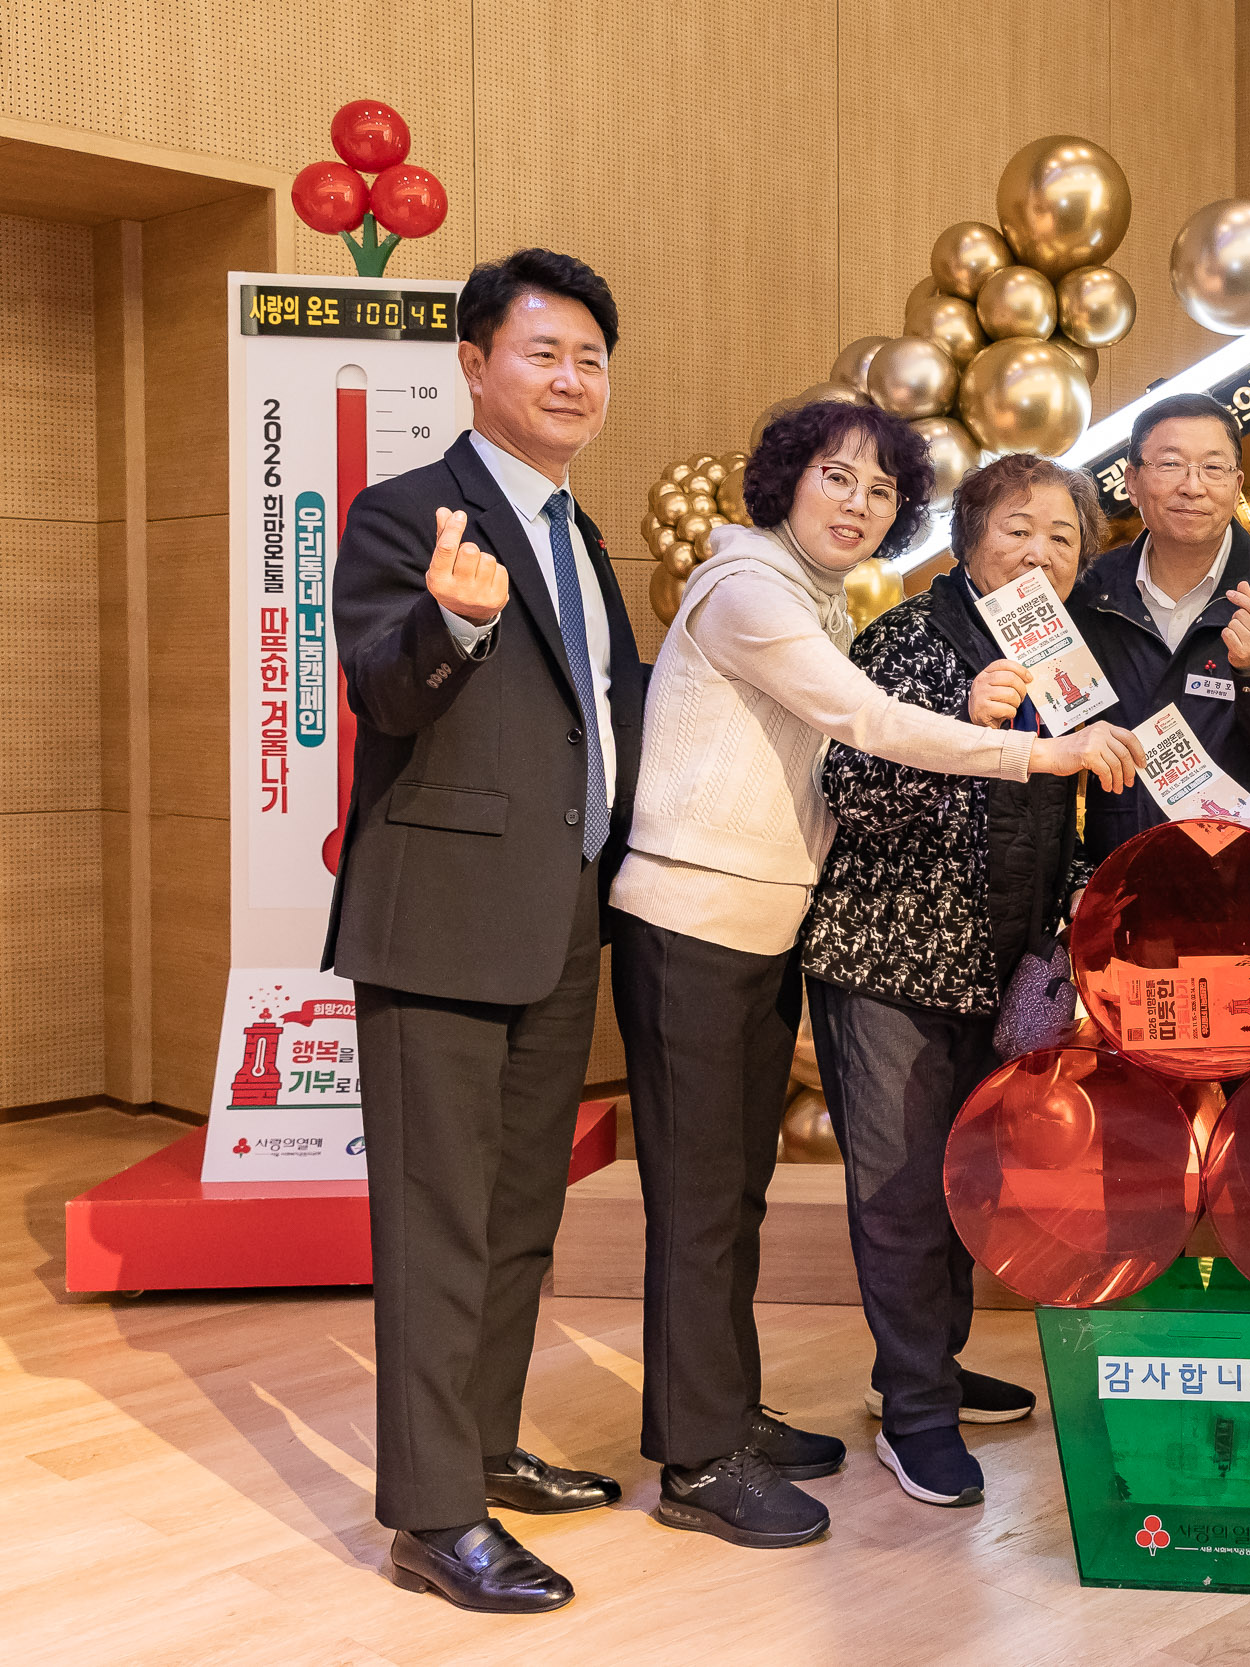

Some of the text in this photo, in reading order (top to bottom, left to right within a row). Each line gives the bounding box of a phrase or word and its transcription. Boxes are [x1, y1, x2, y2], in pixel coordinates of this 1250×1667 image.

[249, 294, 299, 326] 사랑의
[306, 296, 340, 326] 온도
[410, 386, 438, 399] 100
[411, 426, 431, 439] 90
[260, 398, 290, 814] 2026 희망온돌 따뜻한 겨울나기
[298, 507, 325, 736] 우리동네 나눔캠페인
[997, 610, 1017, 627] 2026
[1001, 602, 1057, 642] 따뜻한
[1010, 617, 1064, 654] 겨울나기
[1145, 738, 1194, 779] 따뜻한
[1154, 753, 1201, 791] 겨울나기
[1156, 979, 1176, 1040] 따뜻한
[1148, 1017, 1157, 1039] 2026
[292, 1040, 354, 1064] 행복을
[288, 1070, 351, 1094] 기부로
